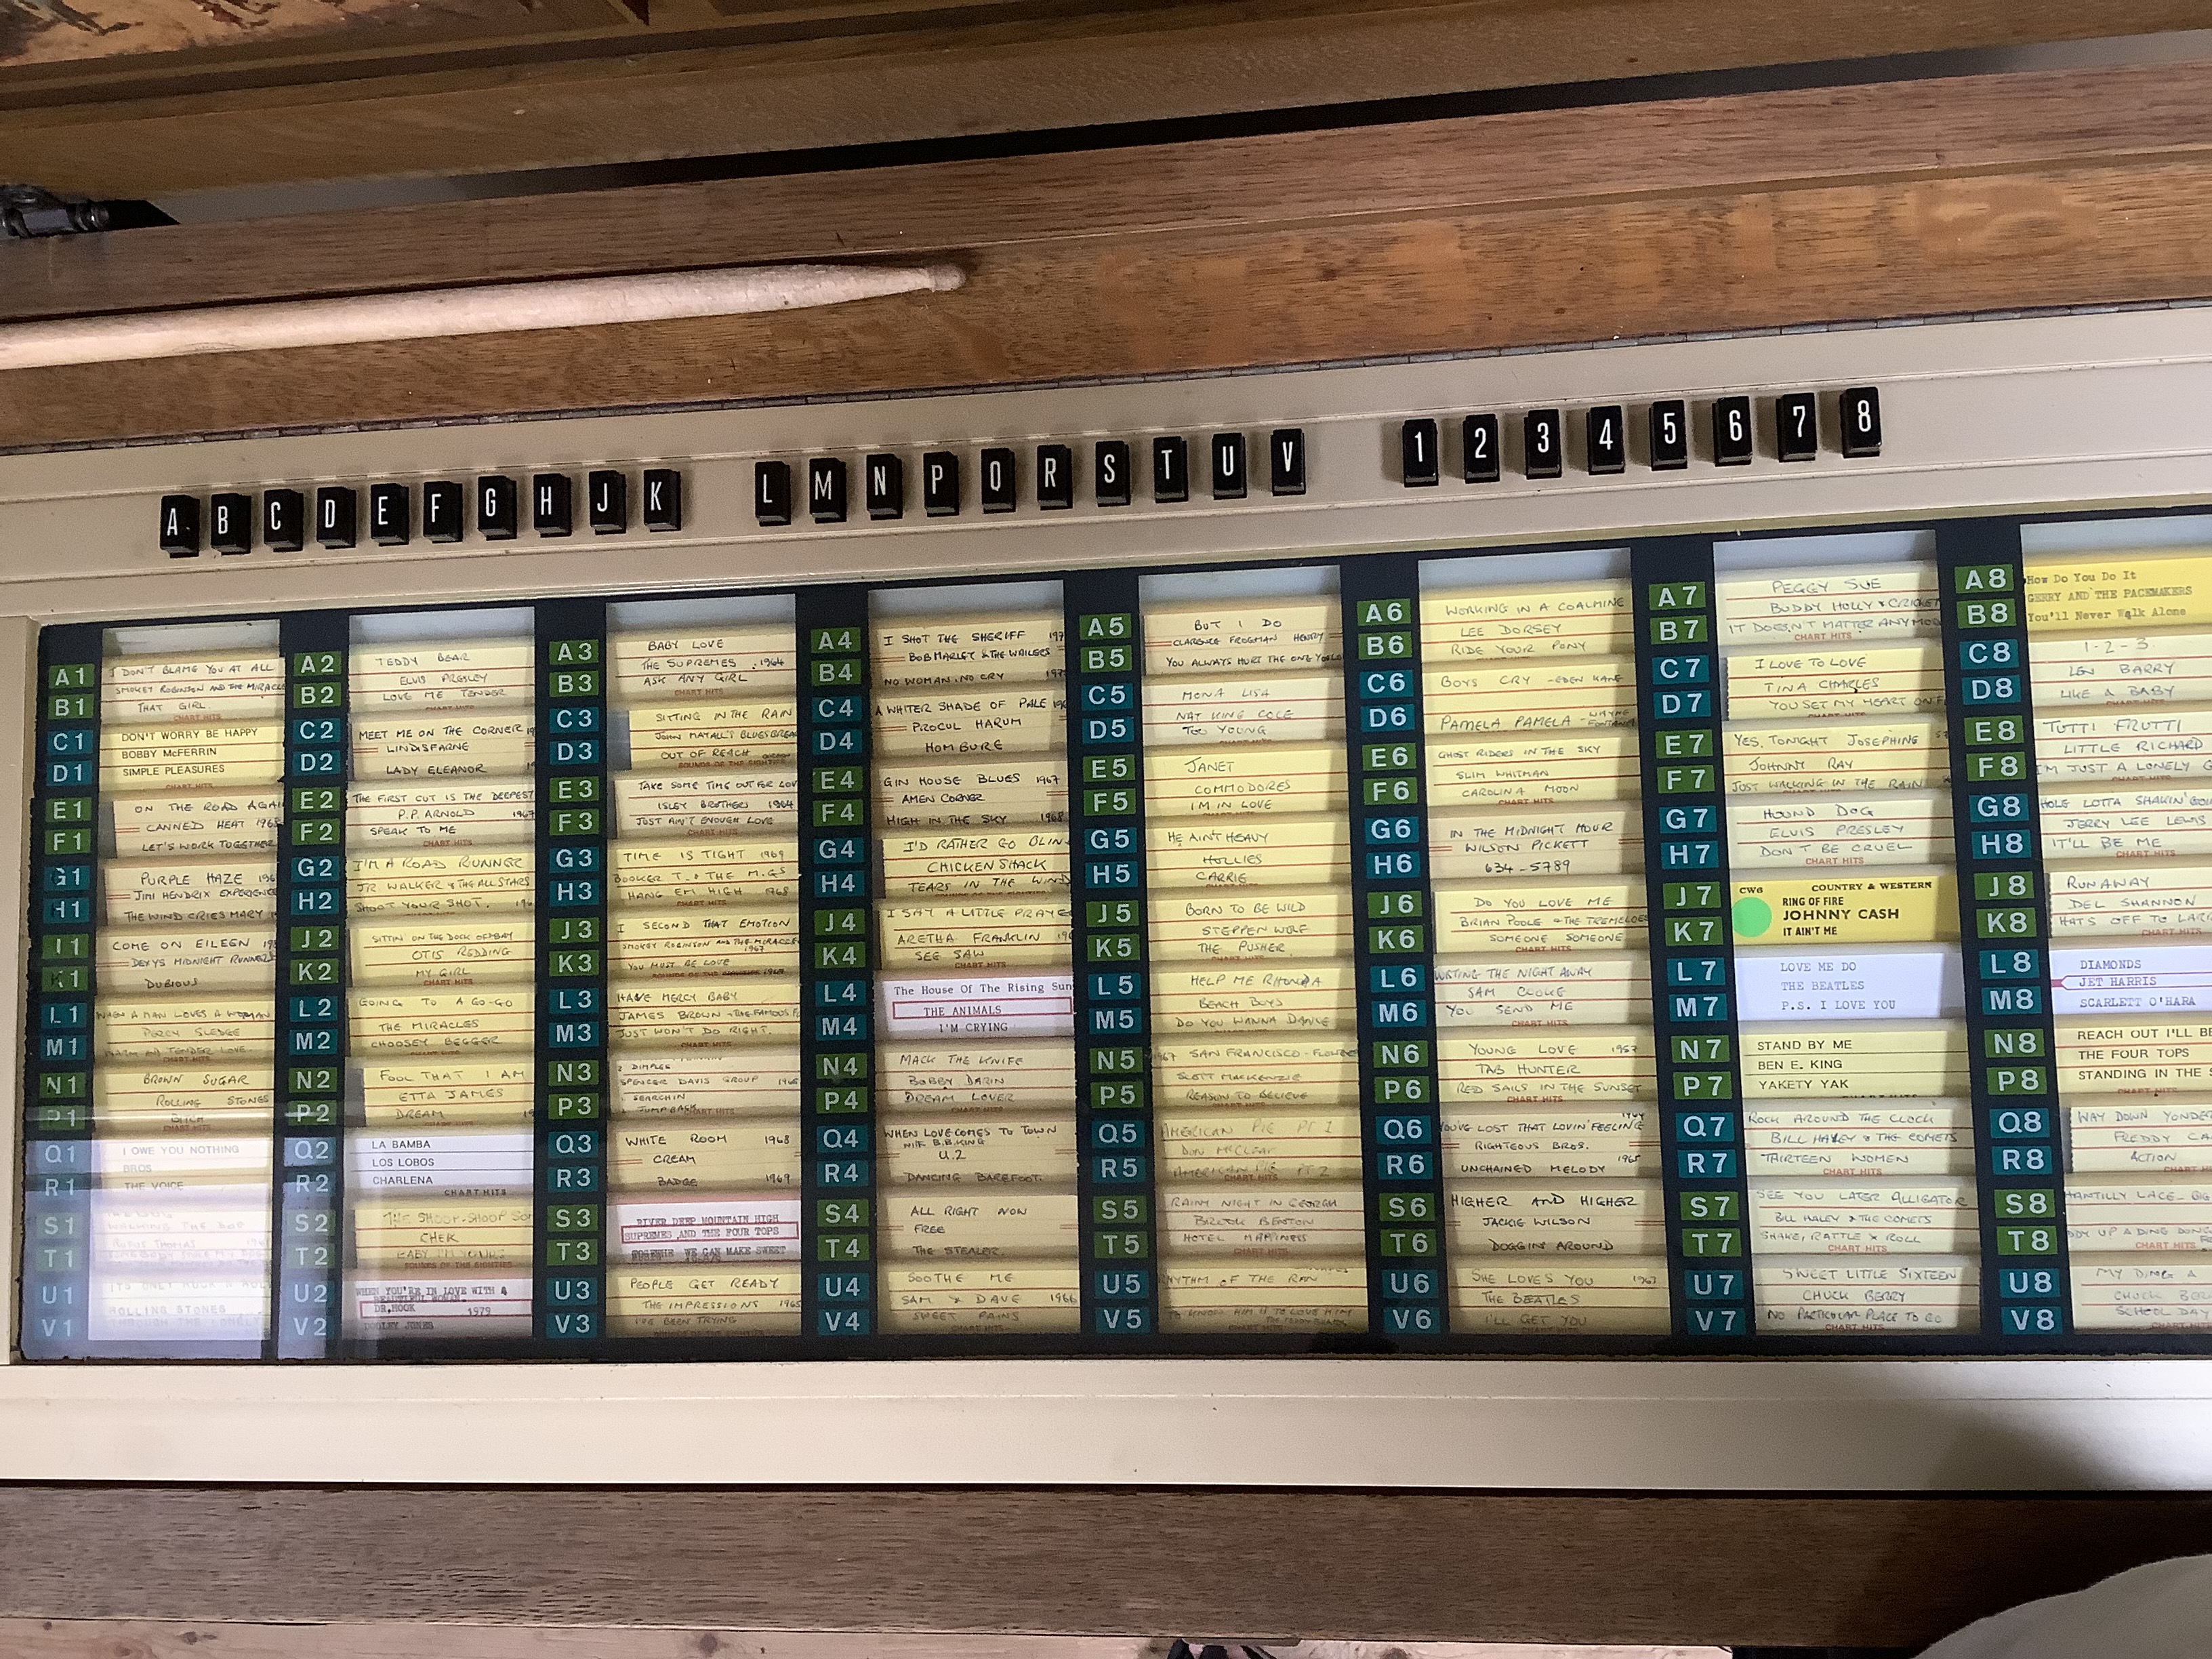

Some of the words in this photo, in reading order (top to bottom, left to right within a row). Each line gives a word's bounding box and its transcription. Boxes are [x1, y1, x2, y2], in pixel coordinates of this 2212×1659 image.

[1415, 432, 1422, 462] 1
[1475, 428, 1486, 458] 2
[1538, 423, 1549, 453] 3
[1599, 419, 1613, 450] 4
[1664, 413, 1676, 444] 5
[1729, 410, 1742, 441] 6
[1793, 406, 1805, 437] 7
[1858, 400, 1871, 432] 8
[763, 474, 772, 503] L
[815, 470, 831, 499] M
[874, 466, 886, 495] N
[932, 465, 943, 494] P
[990, 461, 1000, 491] Q
[1045, 458, 1056, 487] R
[1105, 454, 1115, 483] S
[1162, 450, 1172, 479] T
[1223, 446, 1233, 476] U
[1283, 442, 1292, 472] V
[167, 508, 178, 535] A
[218, 506, 228, 534] B
[271, 502, 281, 530] C
[325, 499, 335, 528] D
[378, 496, 388, 525] E
[432, 493, 441, 522] F
[486, 488, 495, 516] G
[541, 487, 551, 515] H
[597, 483, 607, 512] J
[651, 482, 661, 510] K
[2027, 575, 2047, 585] How
[2054, 575, 2068, 583] Do
[2074, 573, 2095, 582] You
[2102, 572, 2116, 581] Do
[2123, 571, 2136, 579] It
[2068, 591, 2089, 601] AND
[2095, 590, 2117, 599] THE
[2124, 586, 2192, 598] PACEMAKERS
[2028, 611, 2068, 622] You'll
[2075, 611, 2111, 620] Never
[2152, 607, 2186, 617] Alone
[1498, 624, 1561, 635] DORSEY
[122, 733, 155, 741] DON'T
[161, 731, 199, 739] WORRY
[206, 730, 218, 738] BE
[225, 729, 258, 737] HAPPY
[122, 750, 157, 759] BOBBY
[163, 748, 216, 757] McFERRIN
[123, 767, 159, 776] SIMPLE
[165, 764, 224, 775] PLEASURES
[1185, 756, 1234, 773] JANET
[1811, 884, 1862, 892] COUNTRY
[1783, 897, 1805, 906] RING
[1809, 897, 1820, 905] OF
[1824, 897, 1843, 905] FIRE
[1784, 909, 1851, 920] JOHNNY
[1858, 909, 1898, 919] CASH
[1784, 928, 1792, 936] IT
[1796, 926, 1820, 935] AIN'T
[1824, 926, 1837, 935] ME
[1781, 963, 1811, 972] LOVE
[1818, 962, 1833, 971] ME
[1842, 962, 1856, 971] DO
[2081, 960, 2141, 969] DIAMONDS
[1781, 981, 1804, 991] THE
[1812, 981, 1864, 990] BEATLES
[2079, 977, 2103, 987] JET
[2110, 977, 2156, 986] HARRIS
[894, 987, 914, 995] The
[922, 986, 954, 994] House
[960, 985, 972, 994] Of
[980, 984, 1000, 992] The
[1008, 983, 1044, 994] Rising
[1782, 1001, 1810, 1010] P.S.
[1821, 1001, 1826, 1009] I
[1835, 1000, 1865, 1010] LOVE
[1874, 1000, 1895, 1009] YOU
[2080, 998, 2140, 1008] SCARLETT
[2150, 996, 2196, 1006] O'HARA
[924, 1007, 946, 1017] THE
[952, 1006, 1002, 1015] ANIMALS
[939, 1024, 958, 1033] I'M
[966, 1023, 1007, 1031] CRYING
[2078, 1030, 2123, 1040] REACH
[2131, 1029, 2158, 1038] OUT
[2167, 1029, 2192, 1038] I'LL
[1758, 1041, 1801, 1050] STAND
[1808, 1040, 1824, 1049] BY
[1833, 1040, 1851, 1048] ME
[2078, 1050, 2104, 1060] THE
[2112, 1049, 2148, 1059] FOUR
[2156, 1048, 2189, 1058] TOPS
[1759, 1061, 1783, 1070] BEN
[1791, 1061, 1803, 1069] E.
[1811, 1060, 1842, 1069] KING
[2079, 1069, 2146, 1080] STANDING
[2155, 1069, 2167, 1078] IN
[2176, 1068, 2201, 1077] THE
[1759, 1080, 1812, 1089] YAKETY
[1821, 1080, 1848, 1088] YAK
[131, 1147, 154, 1155] OWE
[161, 1146, 184, 1154] YOU
[190, 1145, 239, 1153] NOTHING
[373, 1158, 393, 1167] LOS
[398, 1158, 434, 1166] LOBOS
